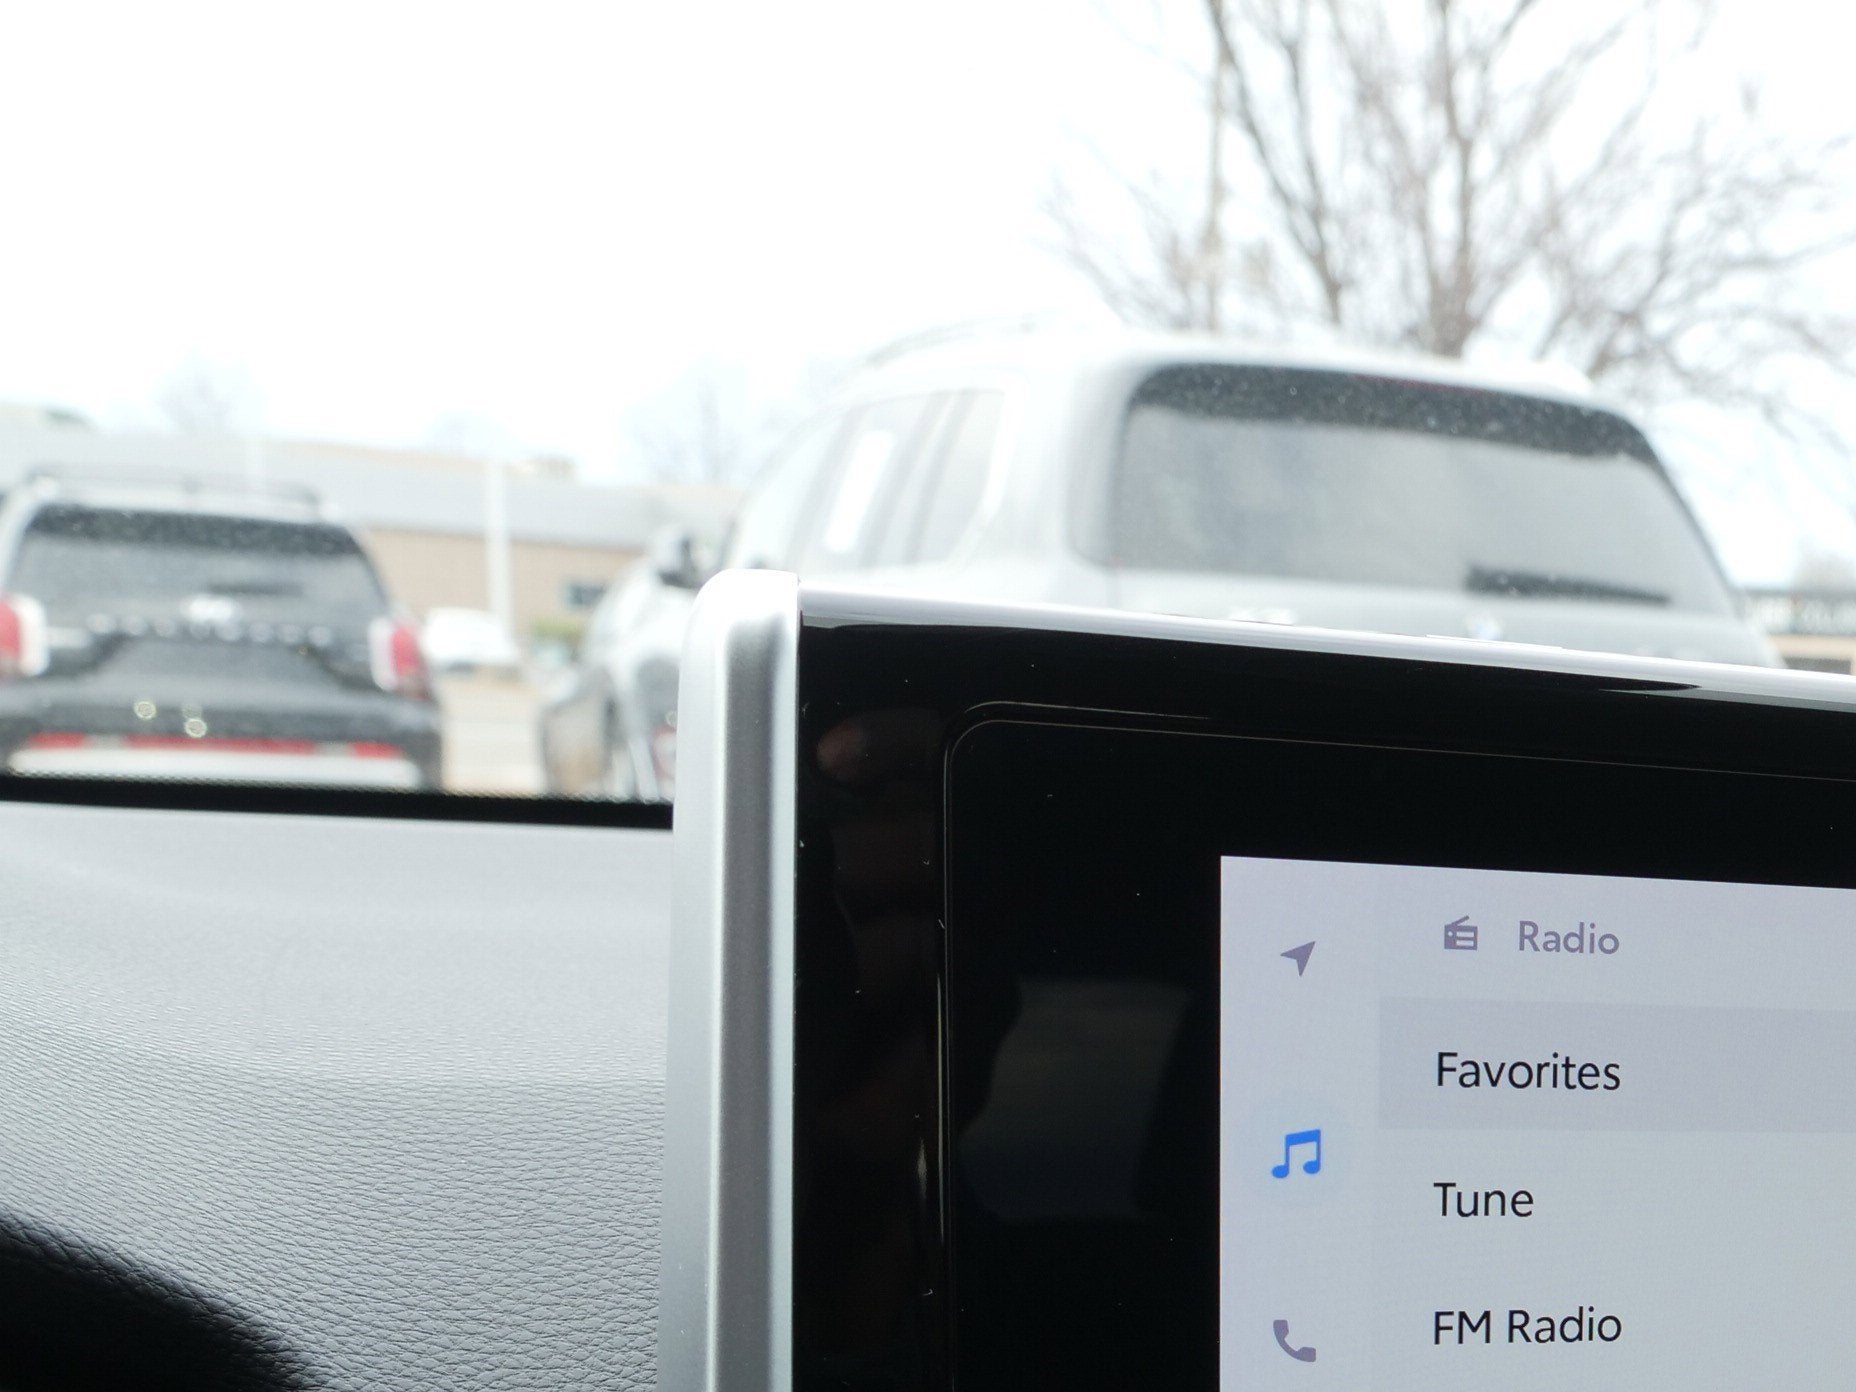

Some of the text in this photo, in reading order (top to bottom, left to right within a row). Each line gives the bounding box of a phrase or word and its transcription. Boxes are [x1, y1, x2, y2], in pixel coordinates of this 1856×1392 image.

[1518, 920, 1620, 955] Radio
[1437, 1051, 1621, 1091] Favorites
[1433, 1182, 1534, 1218] Tune
[1434, 1305, 1622, 1346] FM Radio
